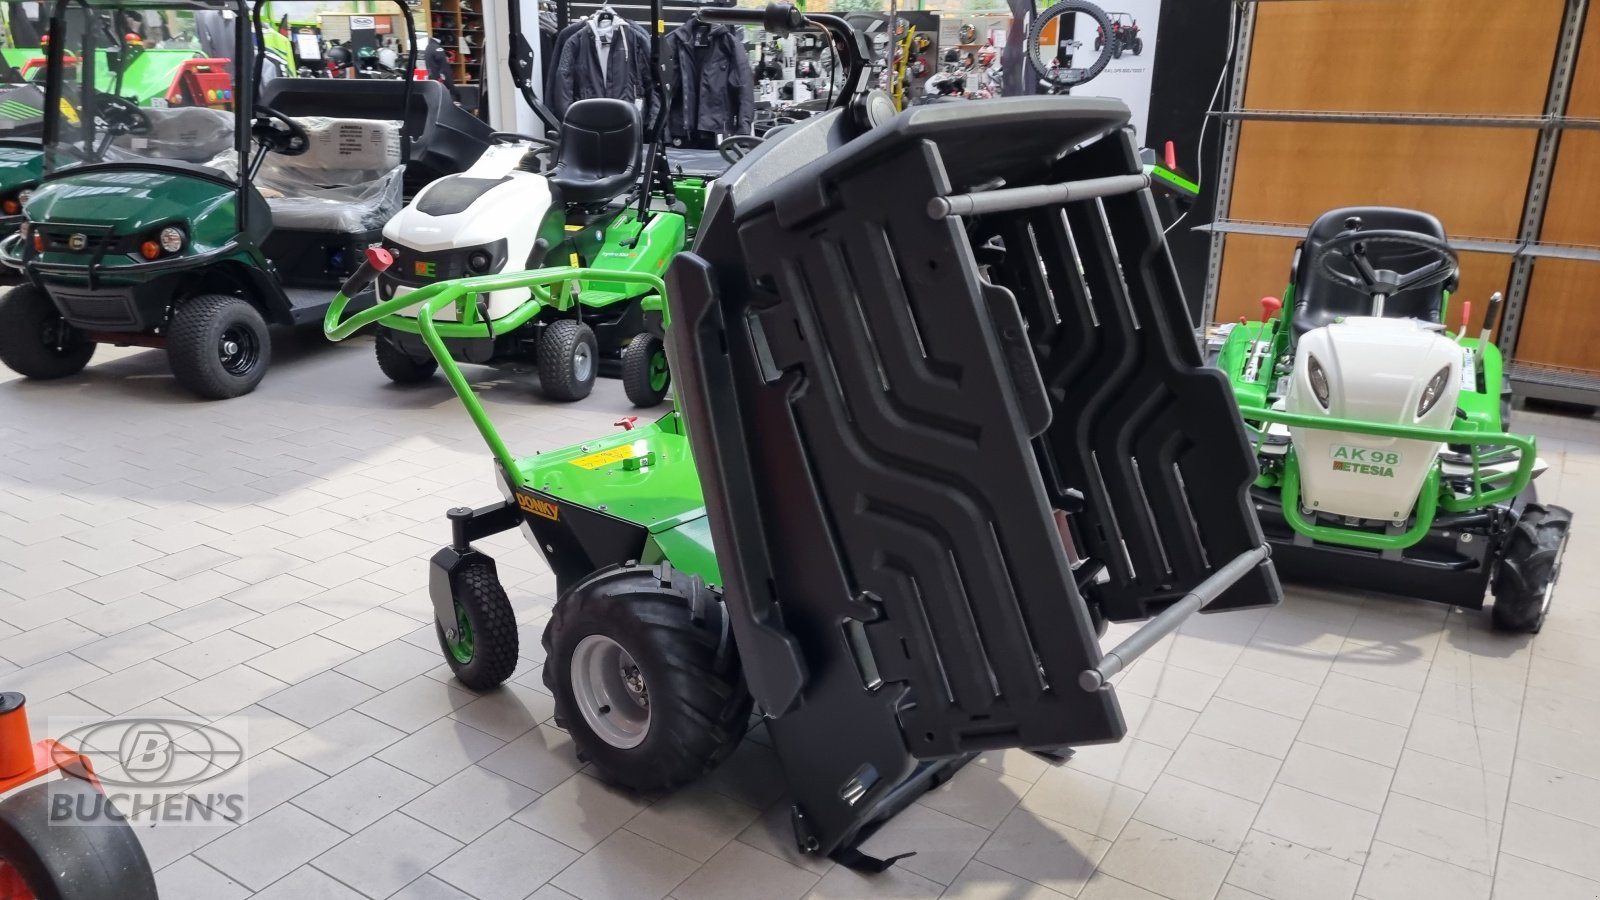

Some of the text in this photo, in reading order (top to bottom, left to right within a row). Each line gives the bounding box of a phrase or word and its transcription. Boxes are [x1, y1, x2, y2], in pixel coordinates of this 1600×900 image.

[1334, 446, 1398, 465] AK 98
[515, 492, 558, 520] DONKY
